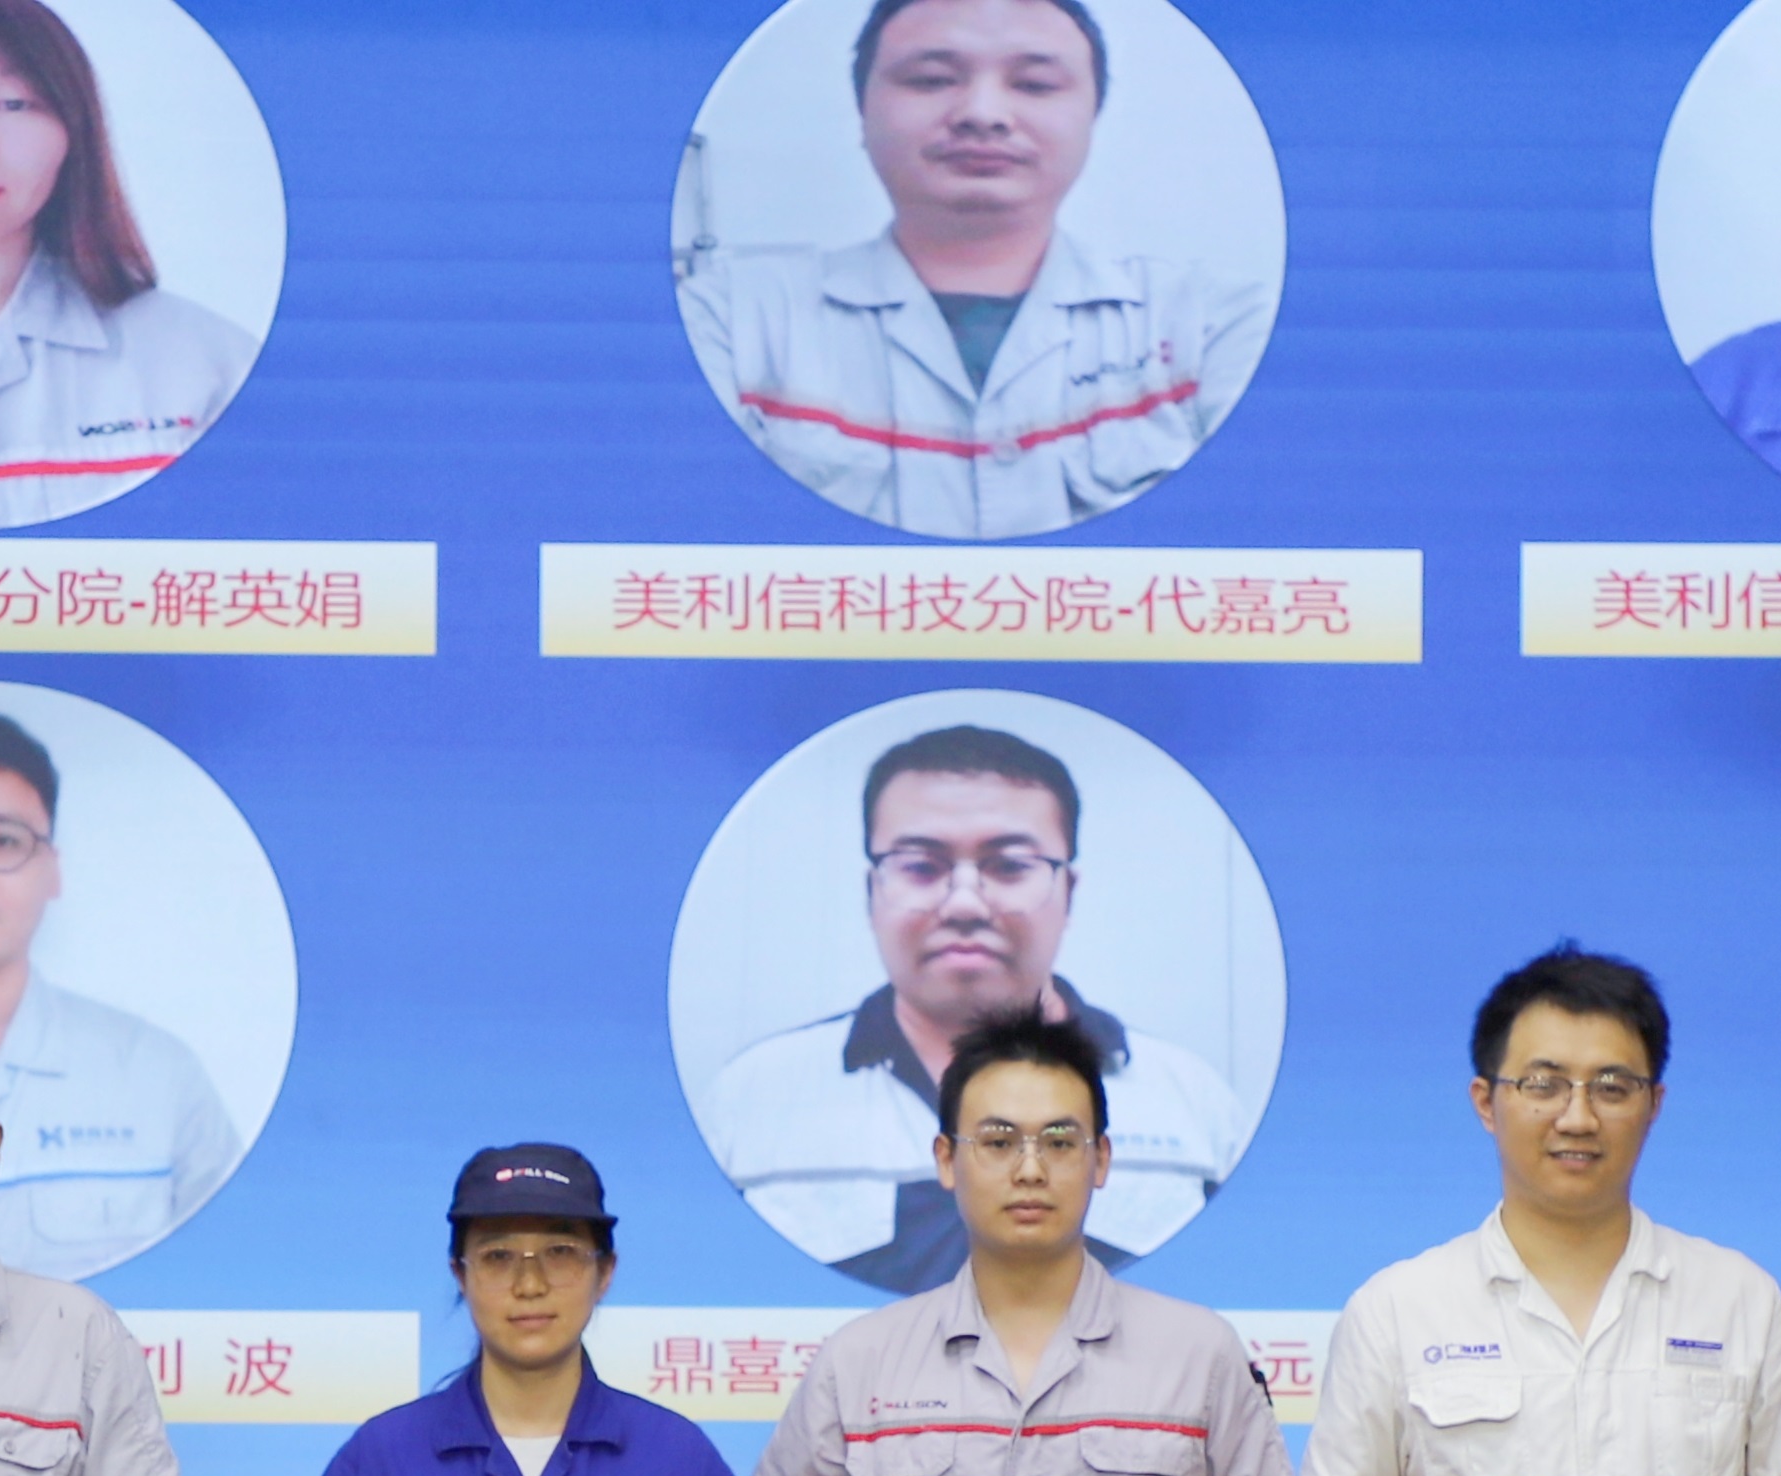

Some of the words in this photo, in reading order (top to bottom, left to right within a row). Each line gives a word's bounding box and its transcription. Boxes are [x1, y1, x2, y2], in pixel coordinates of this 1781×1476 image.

[614, 572, 1352, 635] 美利信科技分院-代嘉亮
[225, 1339, 293, 1397] 波
